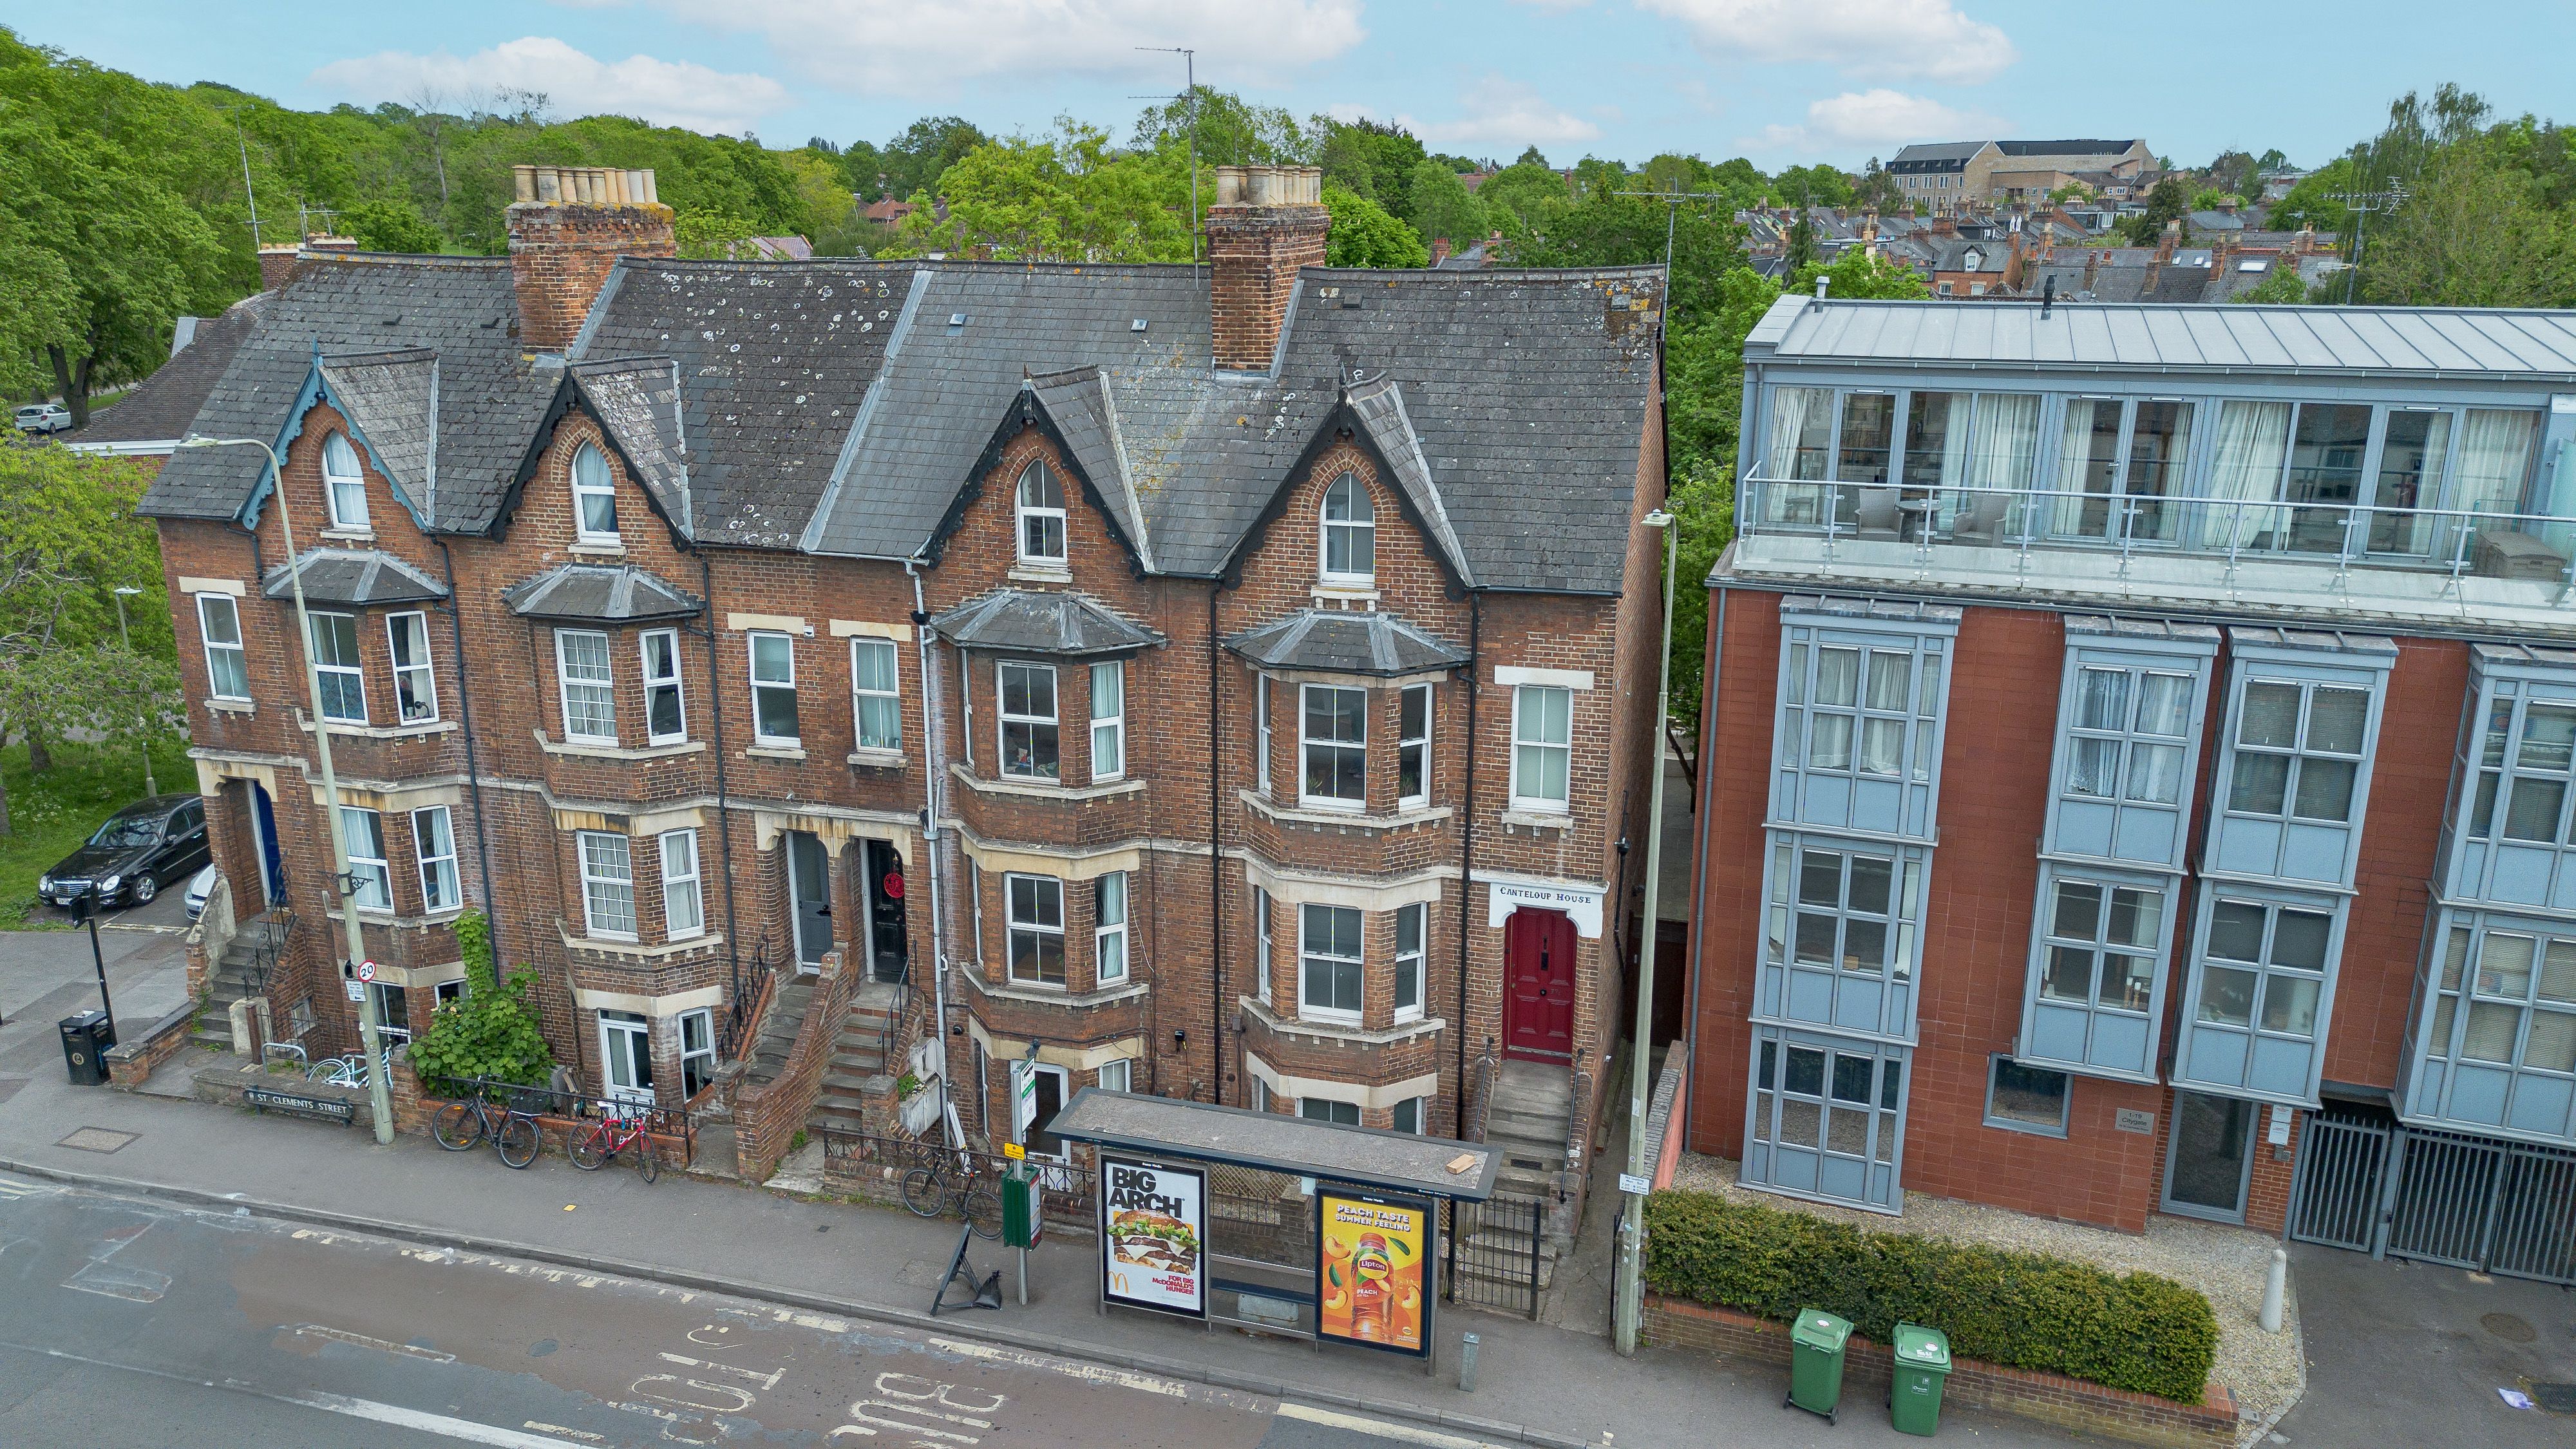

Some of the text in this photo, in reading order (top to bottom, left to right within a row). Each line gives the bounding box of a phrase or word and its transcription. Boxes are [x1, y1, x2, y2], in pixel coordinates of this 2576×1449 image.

[1501, 887, 1591, 904] CANTELOUP HOUSE
[361, 965, 374, 978] 20
[272, 1096, 314, 1109] CLEMENTS
[318, 1103, 347, 1114] STREET
[2122, 1117, 2147, 1126] Citygate
[1112, 1166, 1157, 1193] BIG
[1108, 1188, 1182, 1218] ARCH
[1337, 1204, 1410, 1223] PEACH TASTE
[1335, 1213, 1411, 1233] SUMMER FEELING
[1361, 1260, 1385, 1271] Lipton
[1182, 1276, 1195, 1285] BIG
[1166, 1285, 1195, 1295] HUNGER
